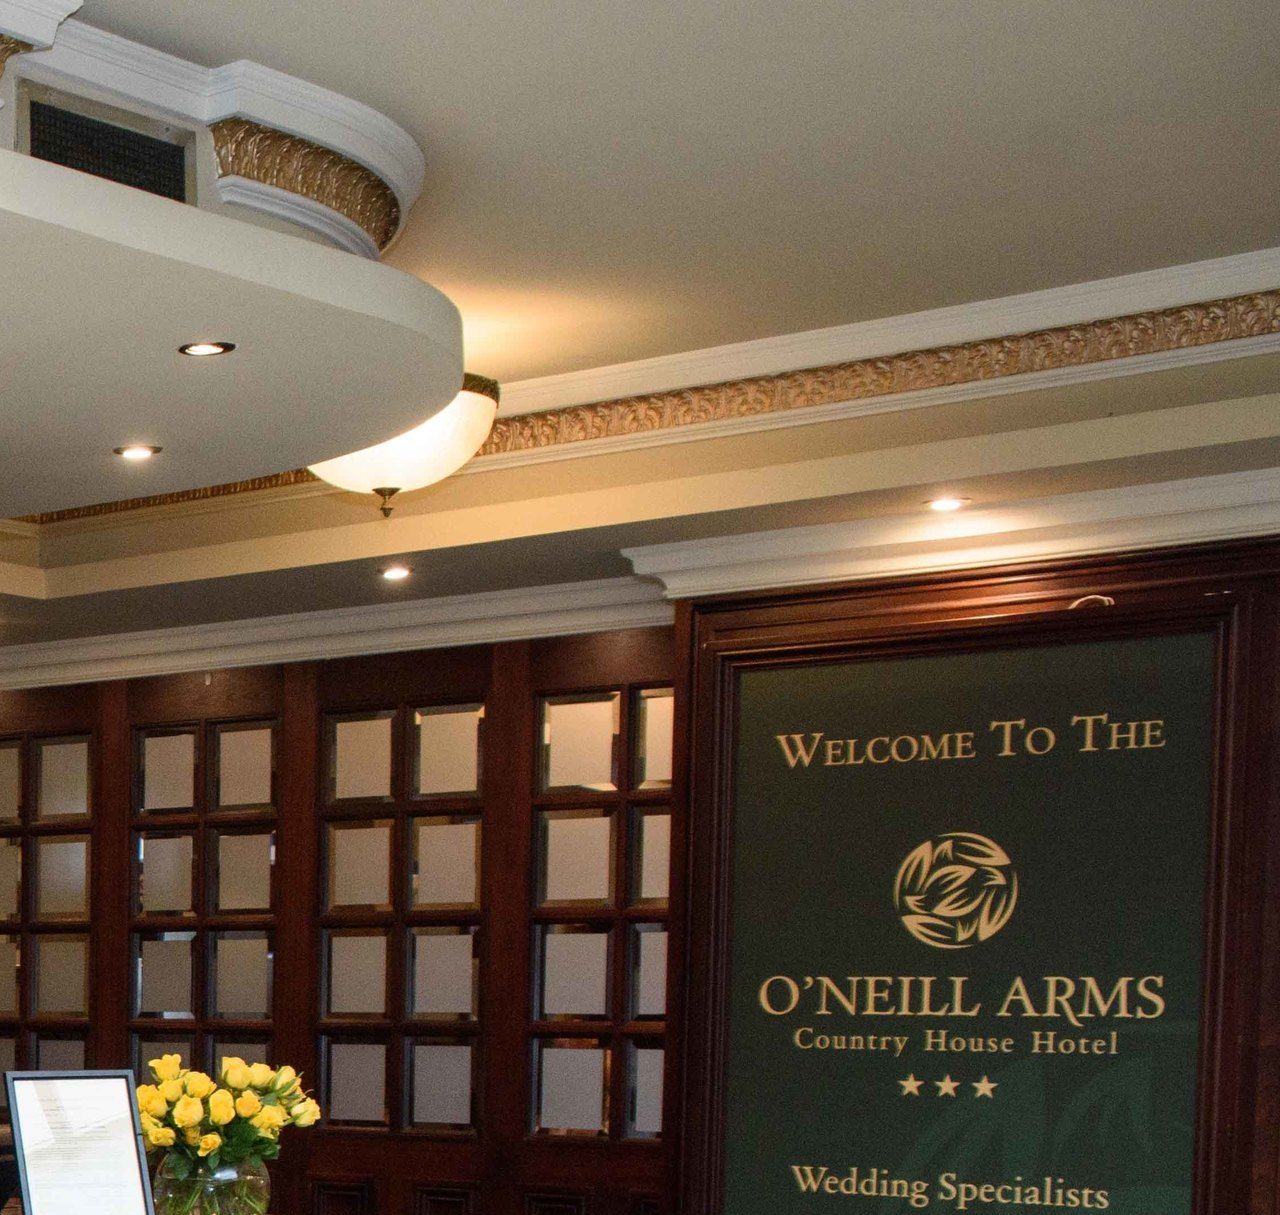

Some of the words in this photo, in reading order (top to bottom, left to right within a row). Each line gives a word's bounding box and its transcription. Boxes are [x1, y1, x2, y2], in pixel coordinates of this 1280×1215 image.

[759, 975, 981, 1017] O'NEILL
[996, 975, 1165, 1027] ARMS
[793, 1027, 909, 1057] Country
[924, 1029, 1014, 1053] House
[1031, 1023, 1118, 1055] Hotel
[791, 1165, 929, 1208] Wedding
[938, 1172, 1110, 1210] Specialists
